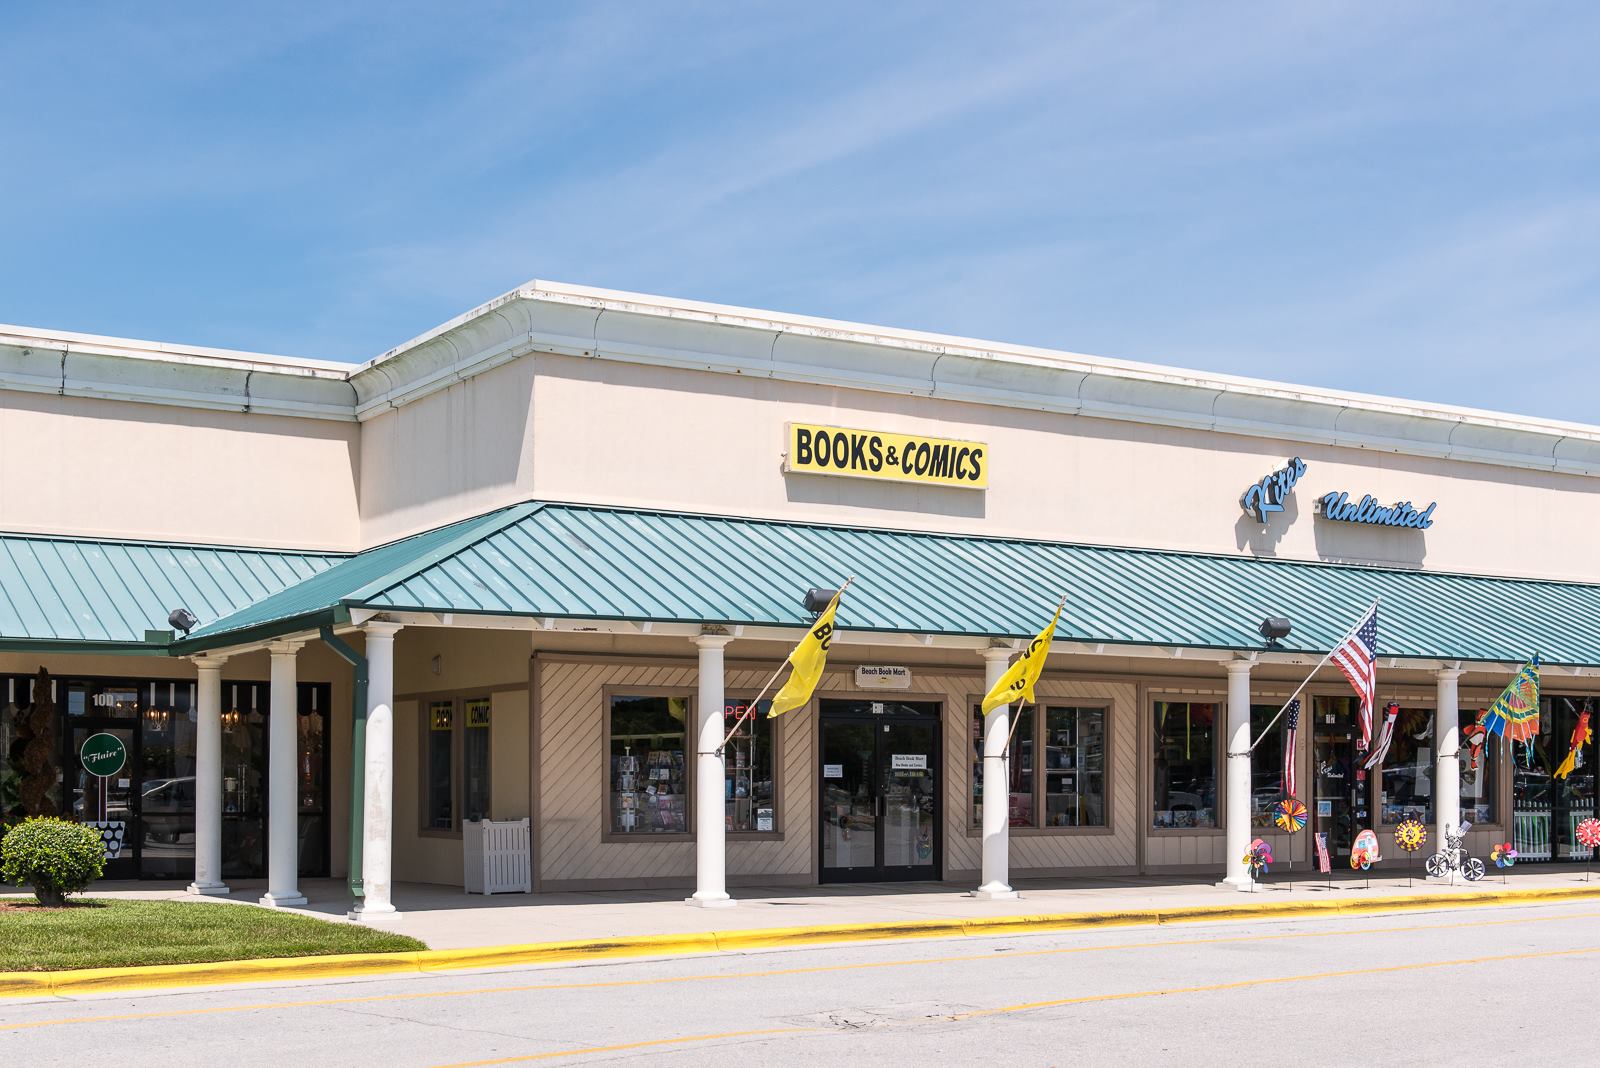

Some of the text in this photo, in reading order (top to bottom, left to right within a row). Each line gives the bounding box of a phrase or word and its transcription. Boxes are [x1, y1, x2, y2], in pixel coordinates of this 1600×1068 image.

[1243, 456, 1307, 523] Kites
[1324, 491, 1437, 530] Unlimited
[861, 667, 906, 676] Beach Book Mart
